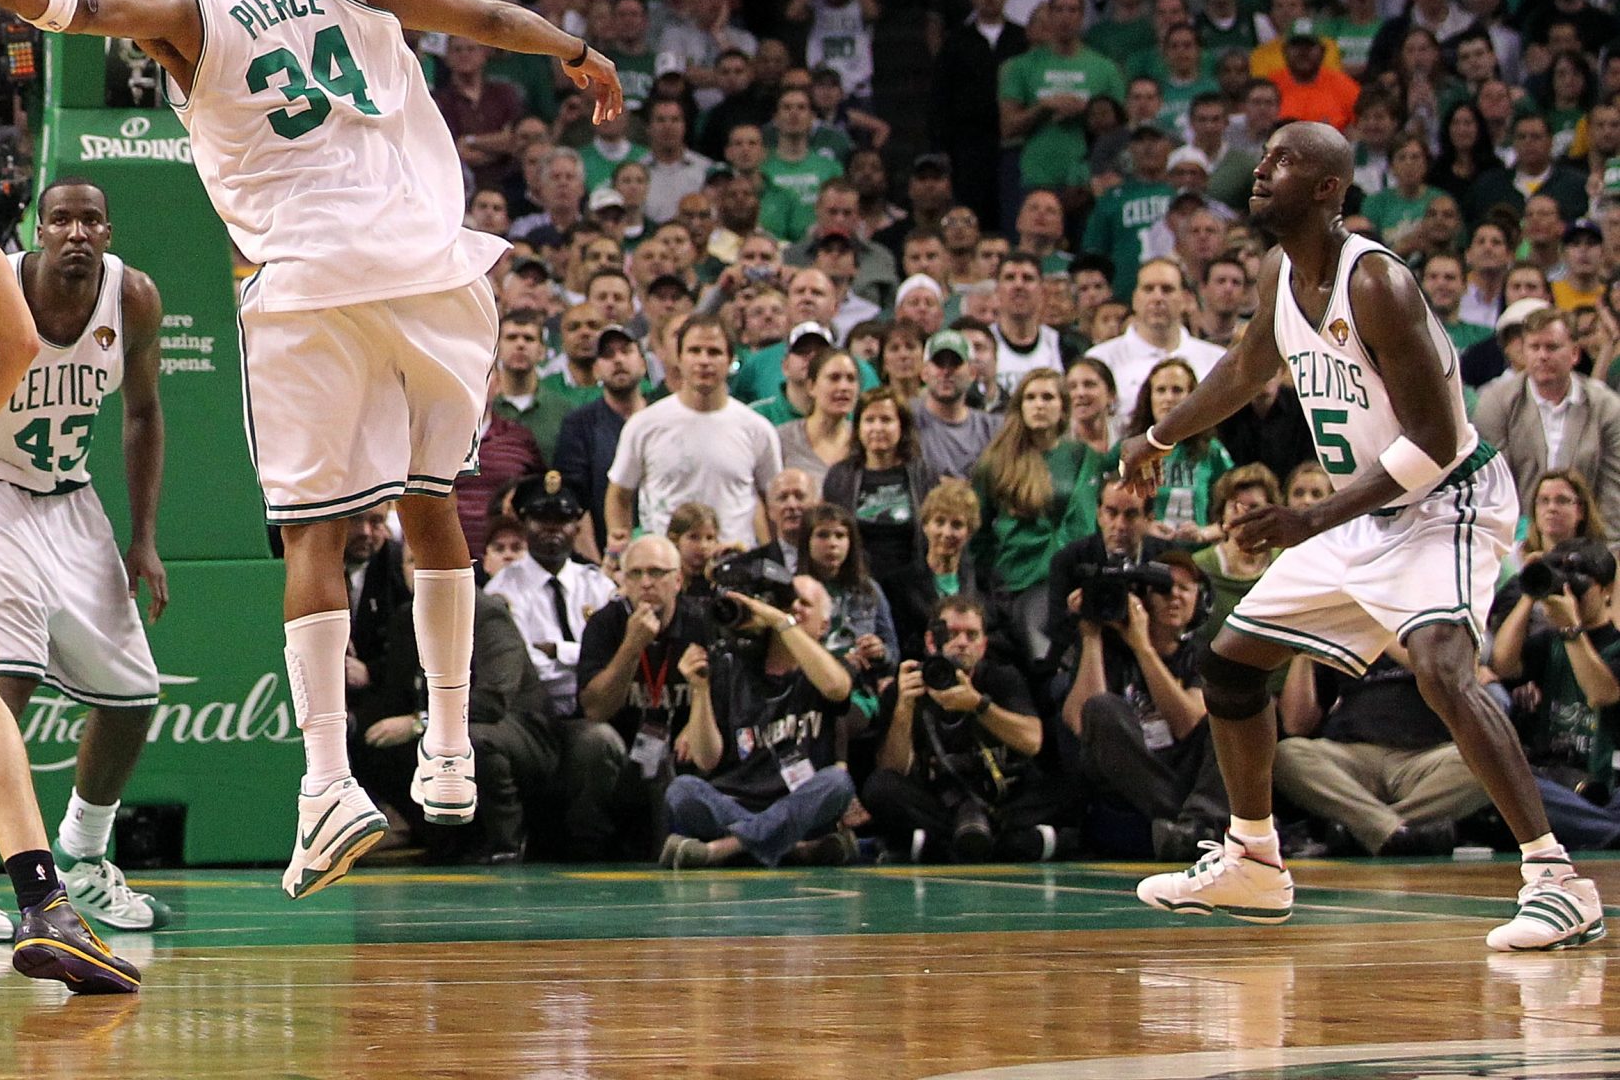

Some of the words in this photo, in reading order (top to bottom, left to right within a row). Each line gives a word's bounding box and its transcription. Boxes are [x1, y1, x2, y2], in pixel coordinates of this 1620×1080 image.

[246, 24, 382, 140] 34
[80, 134, 193, 163] SPALDING
[160, 313, 194, 327] ere
[160, 333, 215, 354] azing
[160, 356, 217, 375] pens.
[14, 413, 96, 472] 43
[1310, 408, 1357, 474] 5
[23, 695, 87, 744] The
[146, 672, 303, 744] nals
